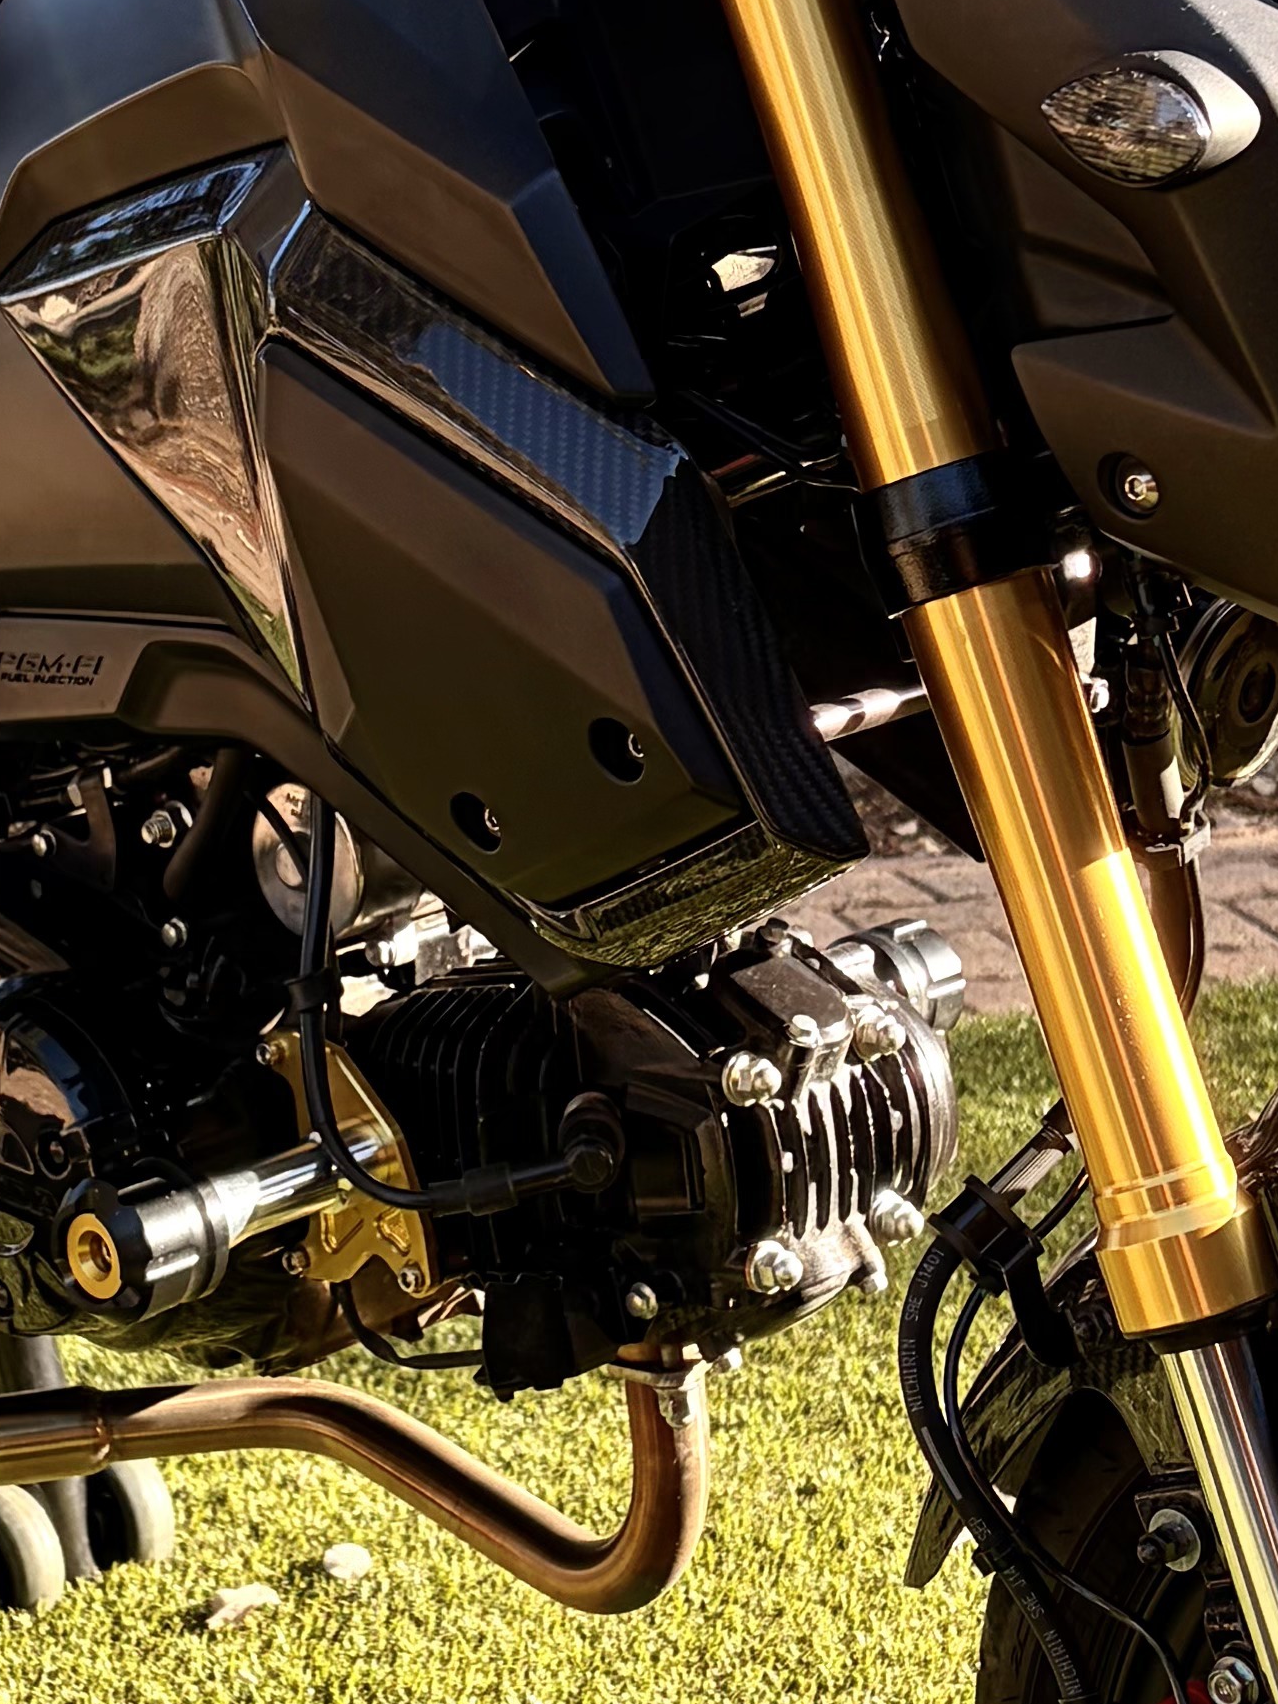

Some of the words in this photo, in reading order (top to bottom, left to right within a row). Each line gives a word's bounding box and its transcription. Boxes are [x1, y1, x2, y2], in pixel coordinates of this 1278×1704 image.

[1, 672, 30, 683] FUEL
[33, 674, 95, 686] INJECTION
[901, 1337, 925, 1413] NICHIRIN
[1042, 1627, 1085, 1697] NICHIRIN
